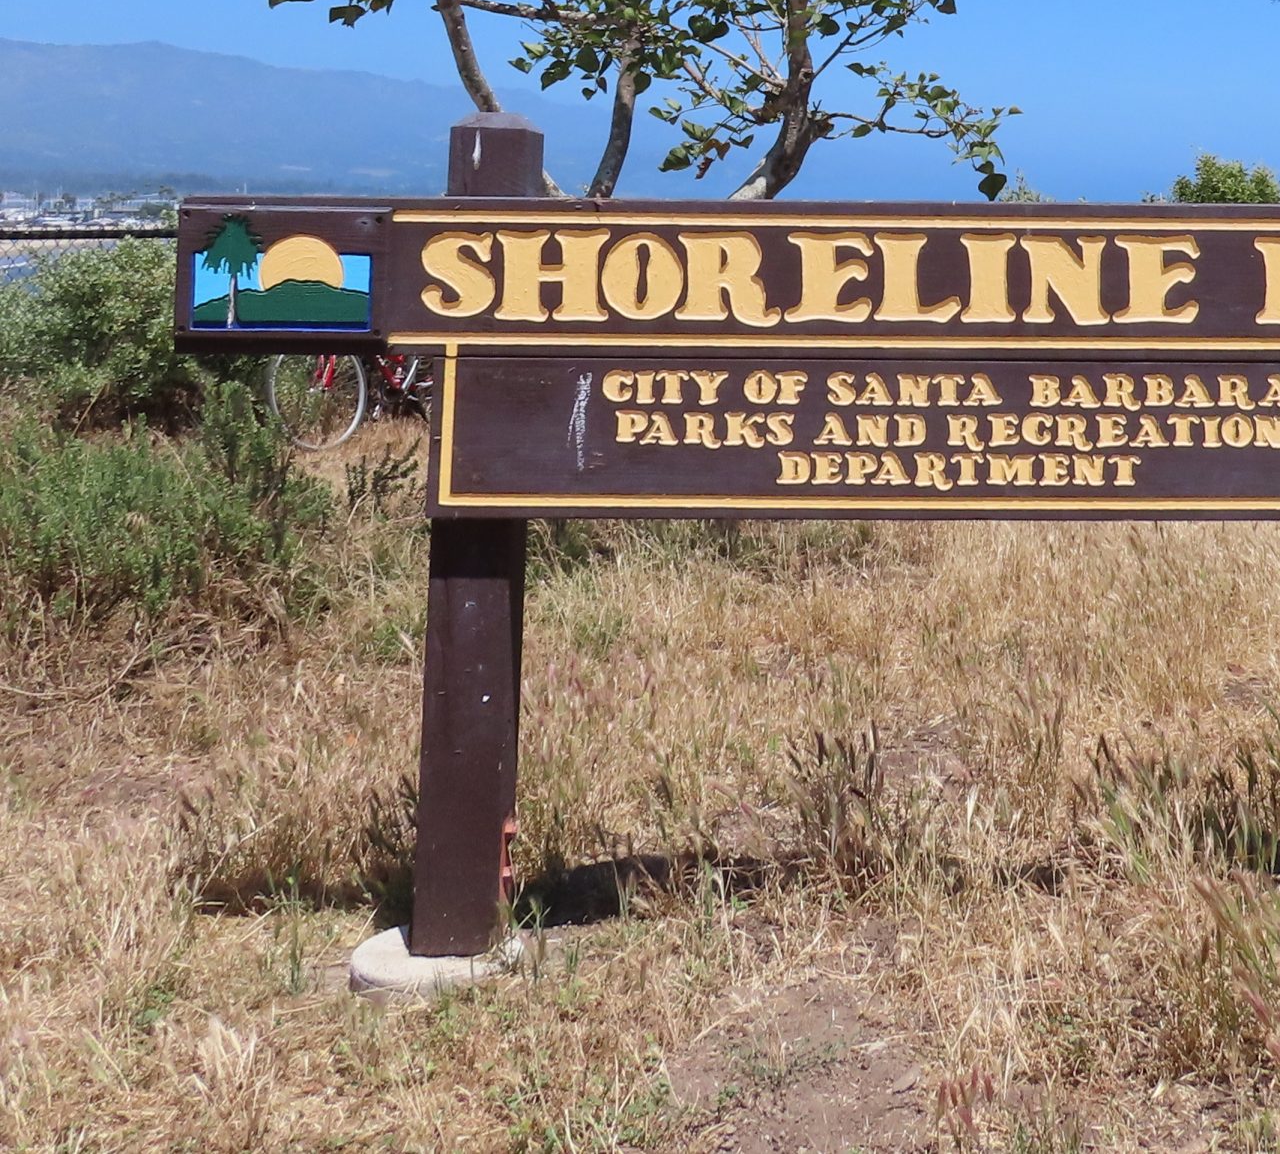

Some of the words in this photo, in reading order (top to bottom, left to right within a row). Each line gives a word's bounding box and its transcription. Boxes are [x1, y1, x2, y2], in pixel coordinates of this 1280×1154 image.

[420, 228, 1201, 327] SHORELINE
[601, 369, 731, 406] CITY
[743, 371, 809, 406] OF
[826, 372, 1002, 408] SANTA
[614, 409, 796, 449] PARKS
[814, 412, 927, 448] AND
[775, 450, 1141, 491] DEPARTMENT
